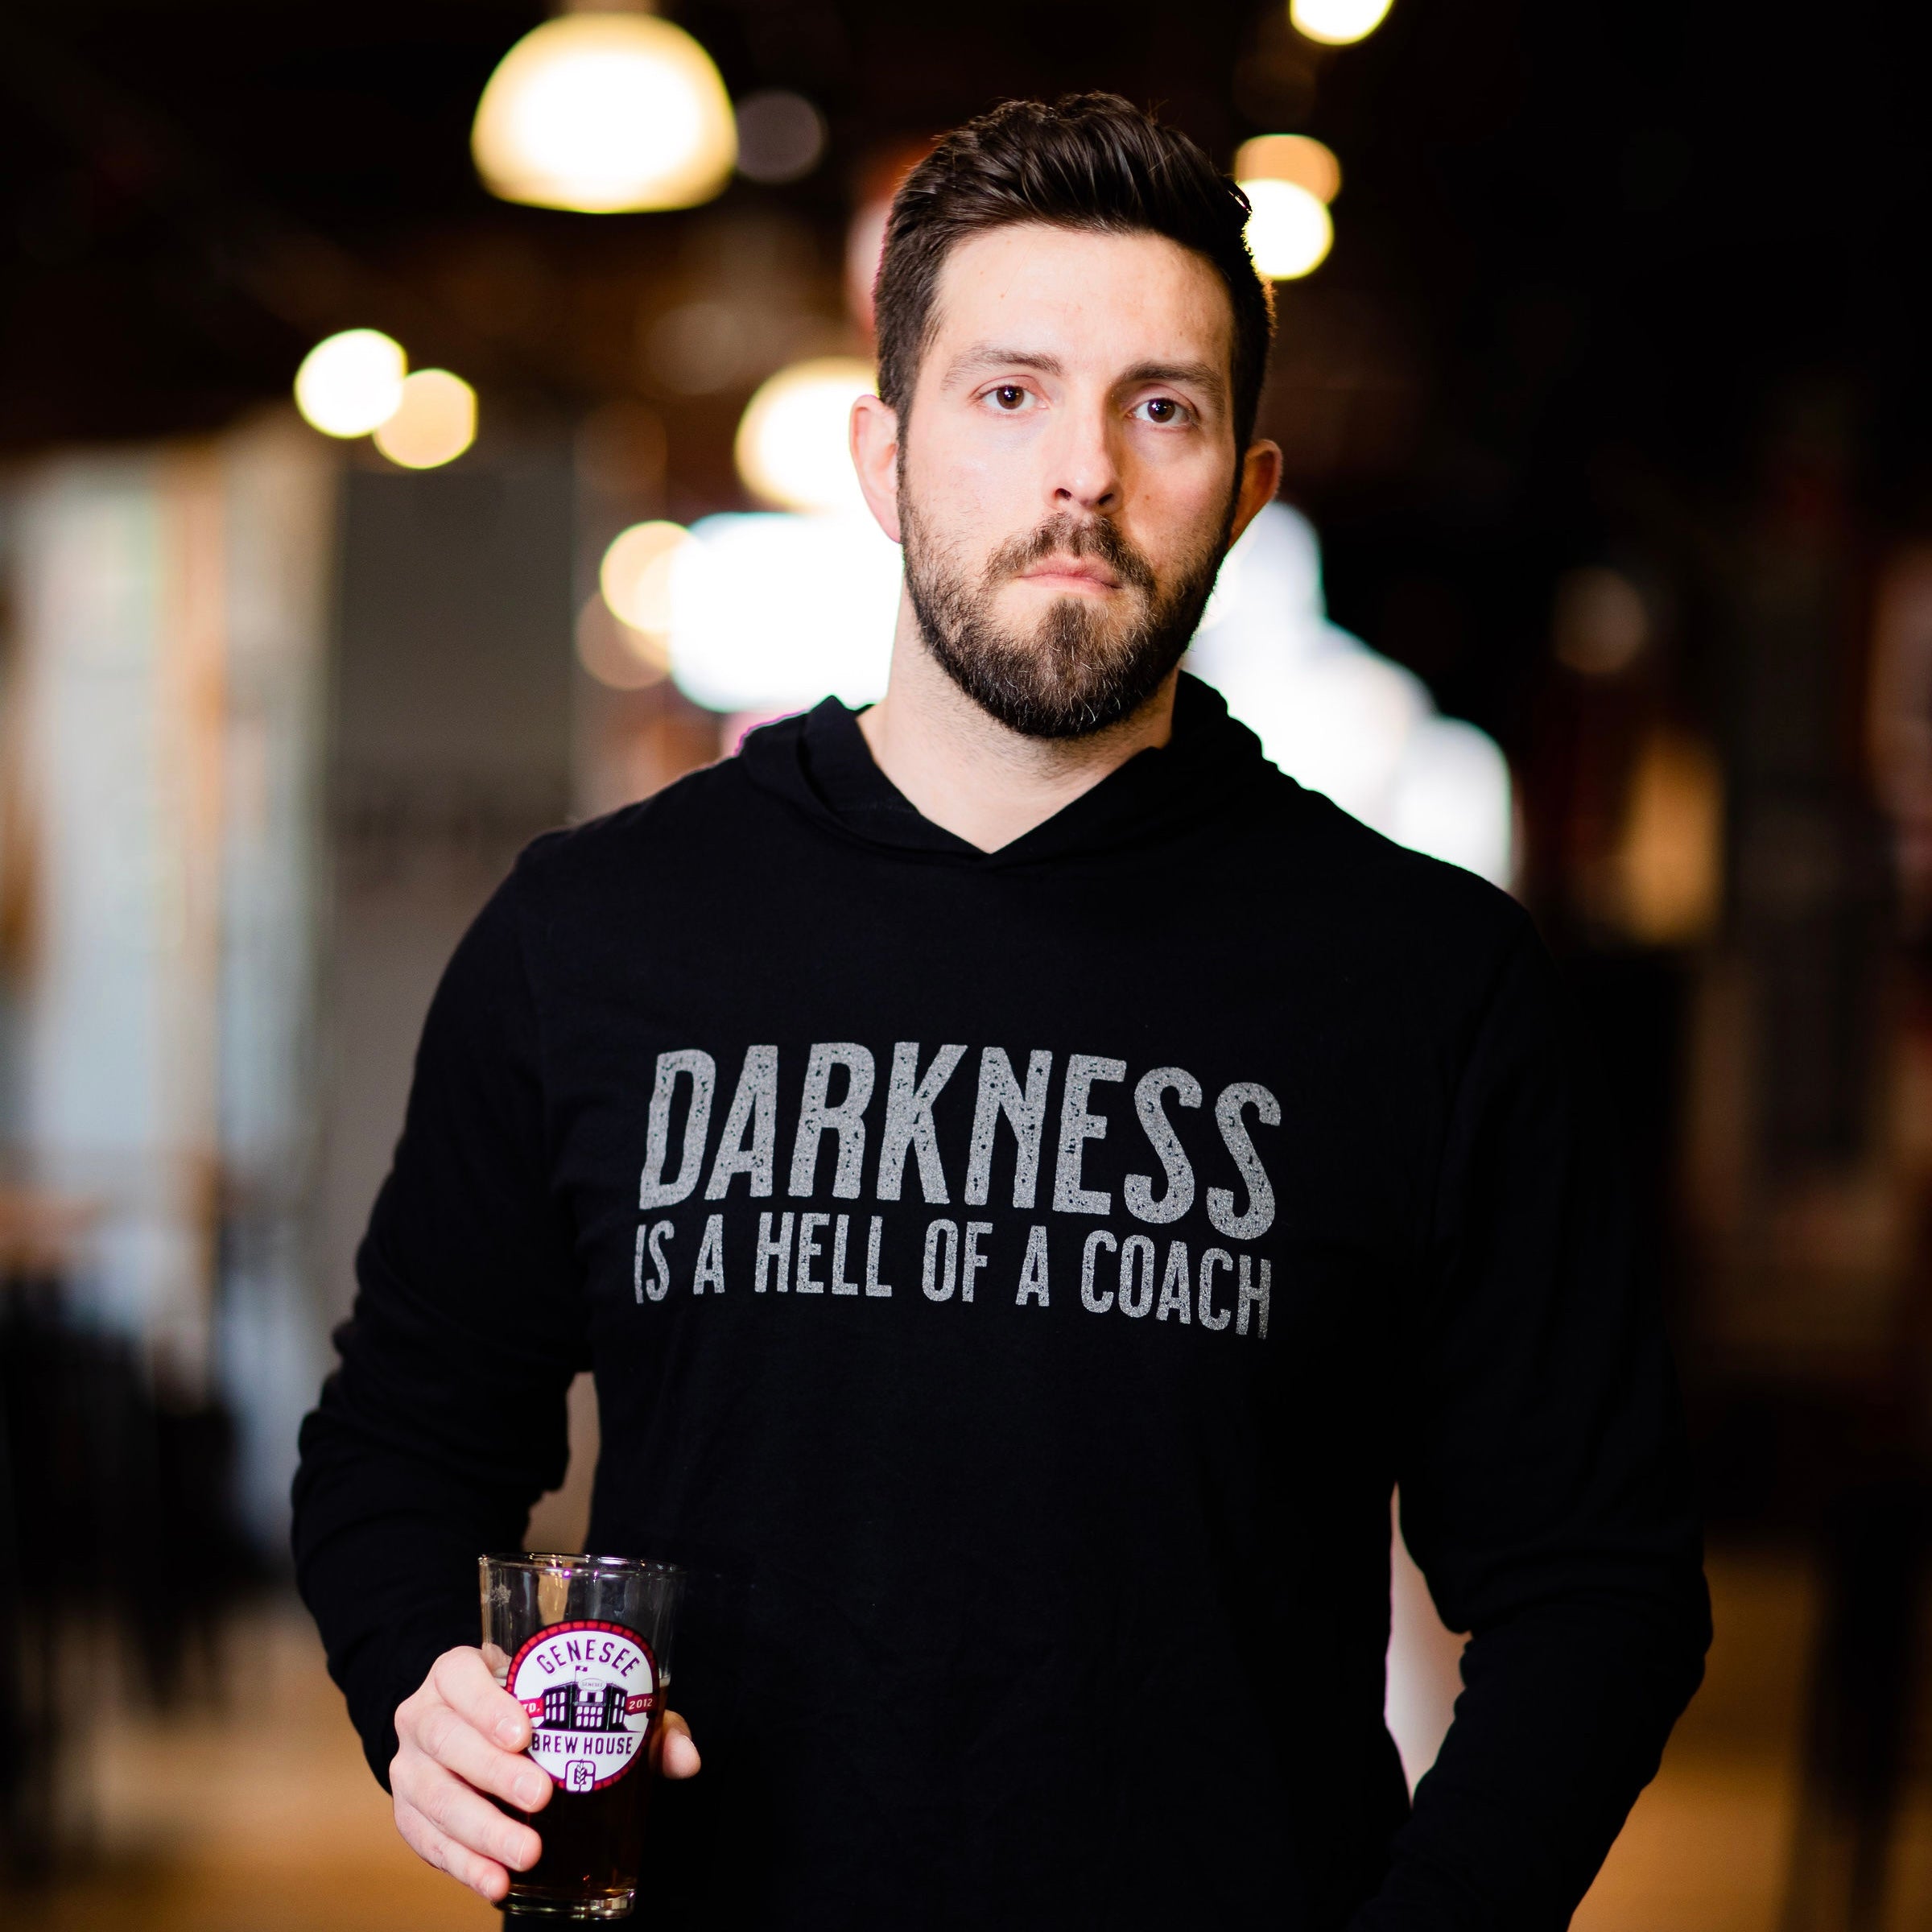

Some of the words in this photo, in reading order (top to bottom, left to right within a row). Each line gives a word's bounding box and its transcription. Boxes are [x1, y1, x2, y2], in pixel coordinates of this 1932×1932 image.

[638, 1041, 1282, 1241] DARKNESS
[634, 1220, 675, 1304] IS
[693, 1213, 725, 1295] A
[753, 1211, 893, 1298] HELL
[921, 1218, 994, 1303] OF
[1014, 1224, 1051, 1307] A
[1080, 1229, 1272, 1340] COACH
[536, 1639, 640, 1678] GENESEE
[628, 1698, 653, 1710] 2012
[531, 1732, 578, 1754] BREW
[583, 1736, 634, 1755] HOUSE
